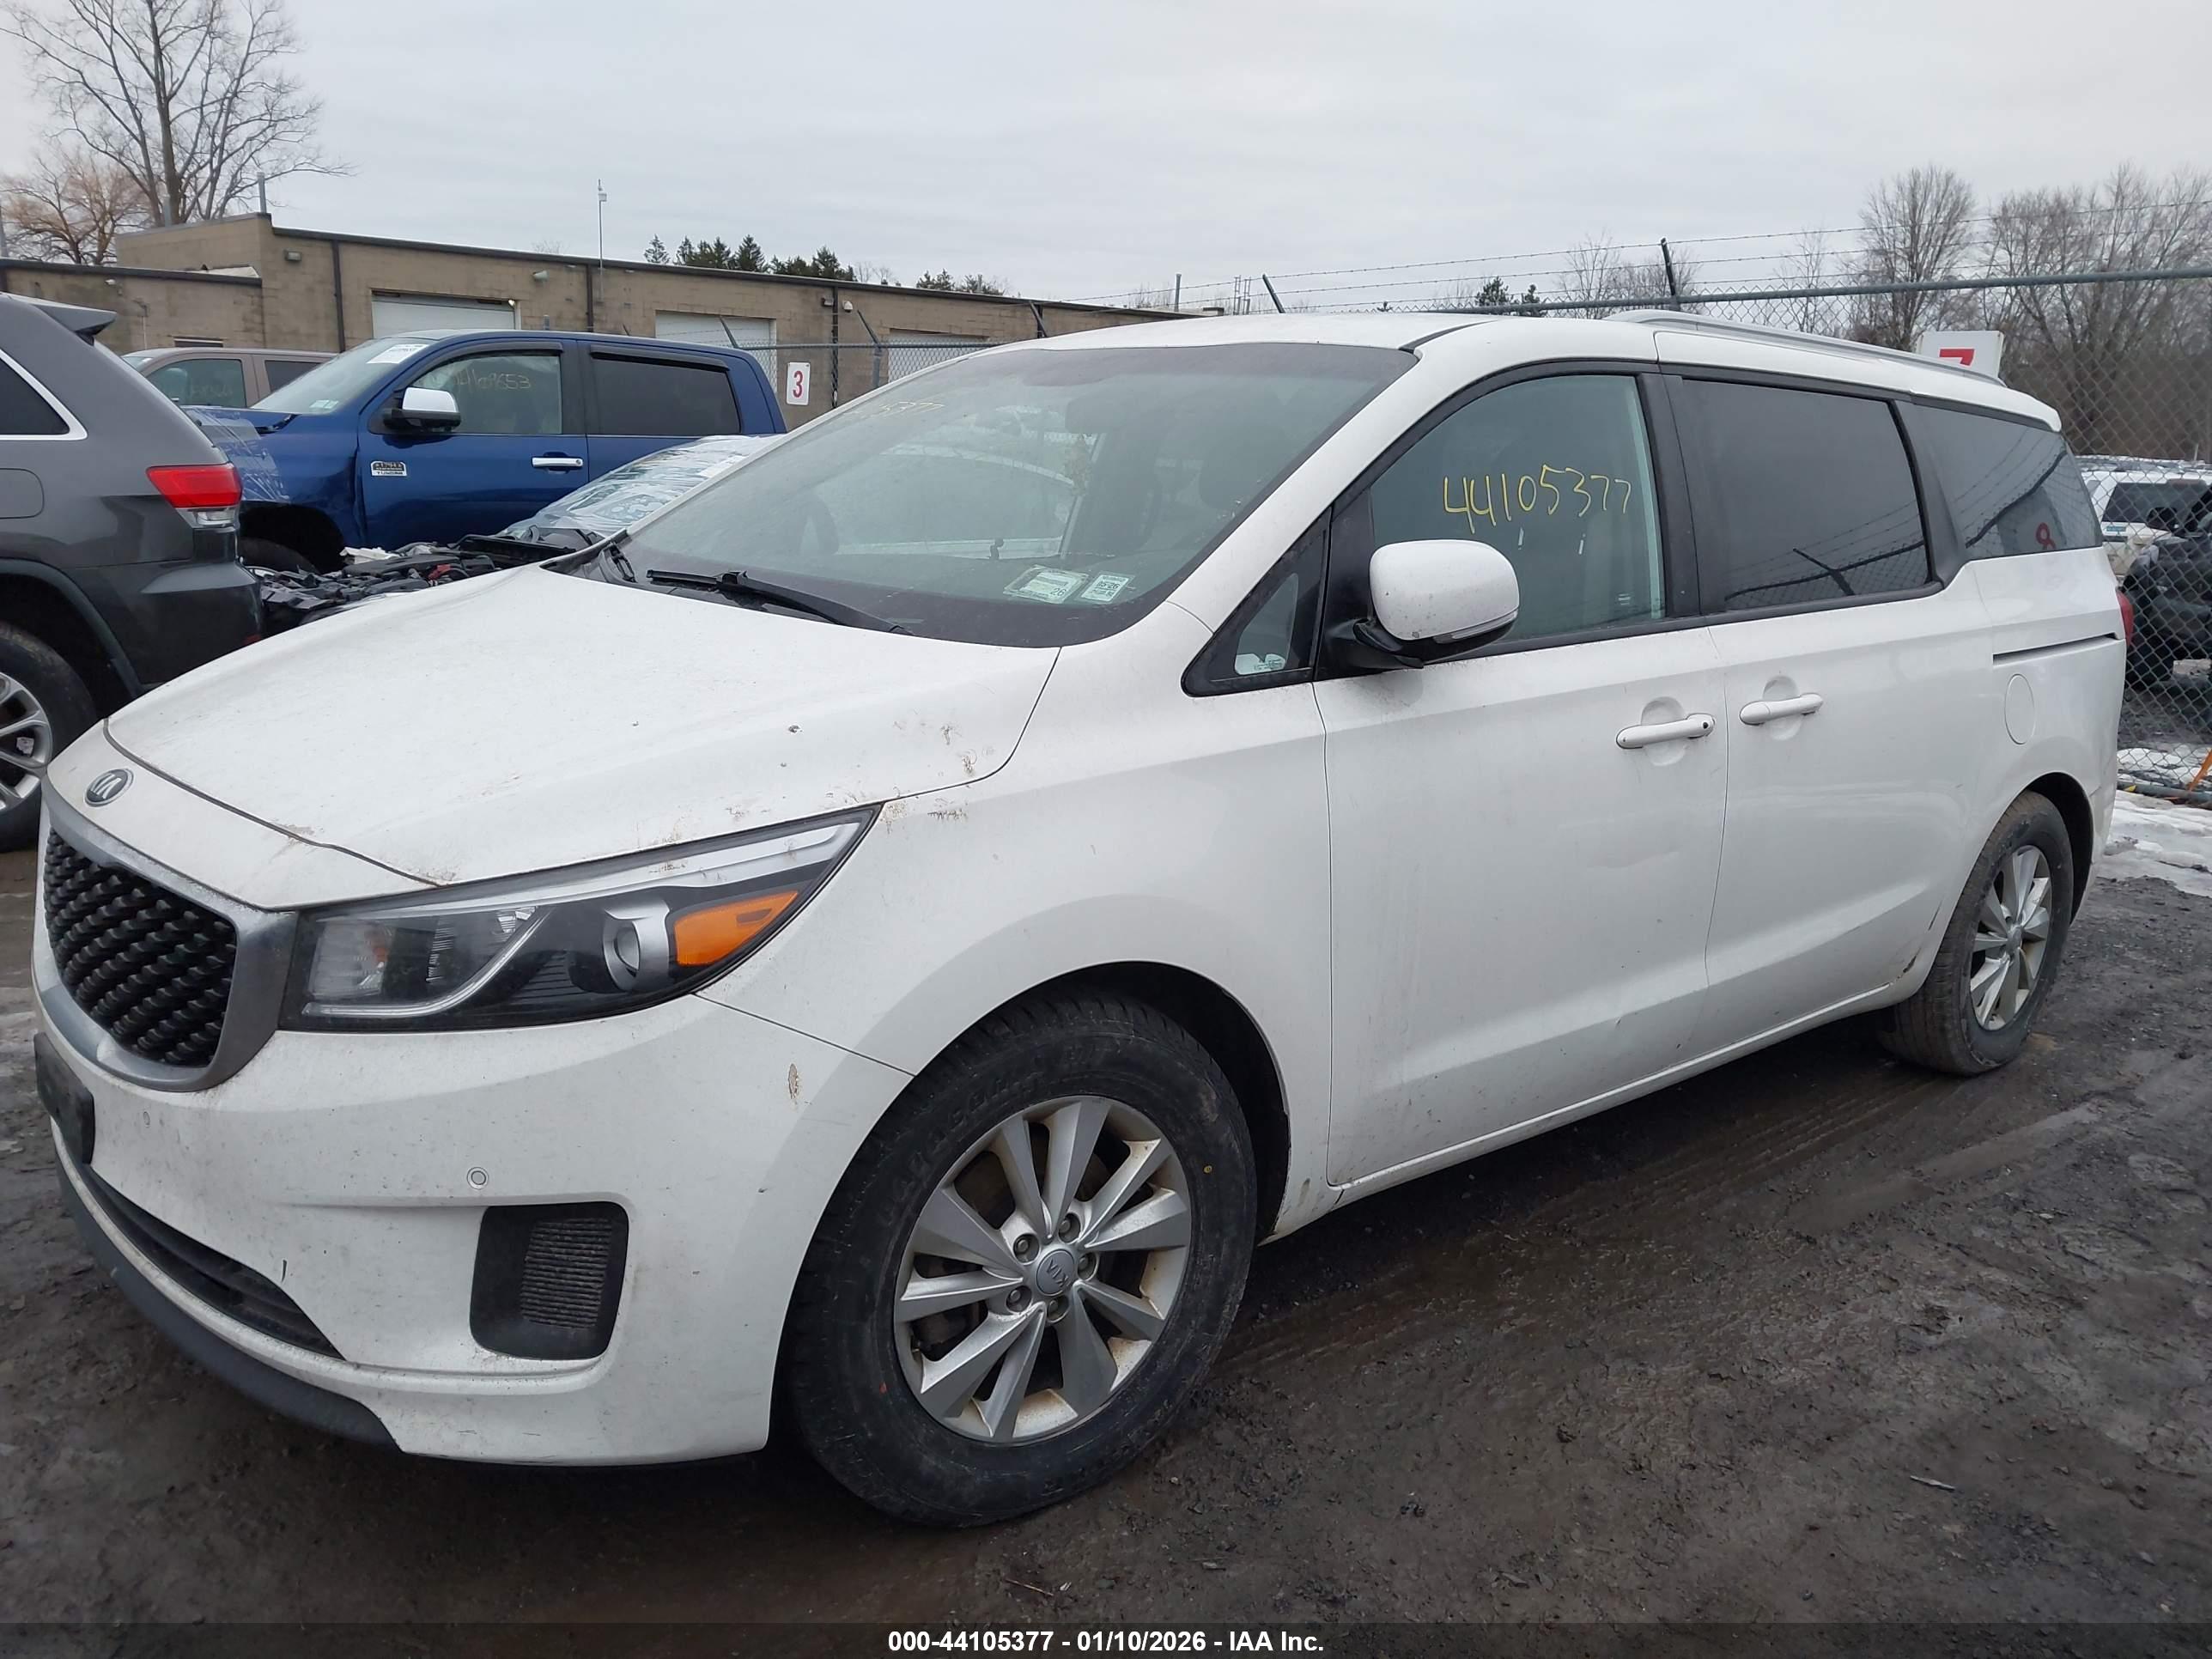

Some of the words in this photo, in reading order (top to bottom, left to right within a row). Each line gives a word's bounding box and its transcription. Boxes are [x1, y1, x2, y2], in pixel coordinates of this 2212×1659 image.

[792, 370, 804, 398] 3
[1443, 463, 1632, 534] 44105377
[1050, 587, 1067, 597] 26
[1045, 1257, 1073, 1288] KIA
